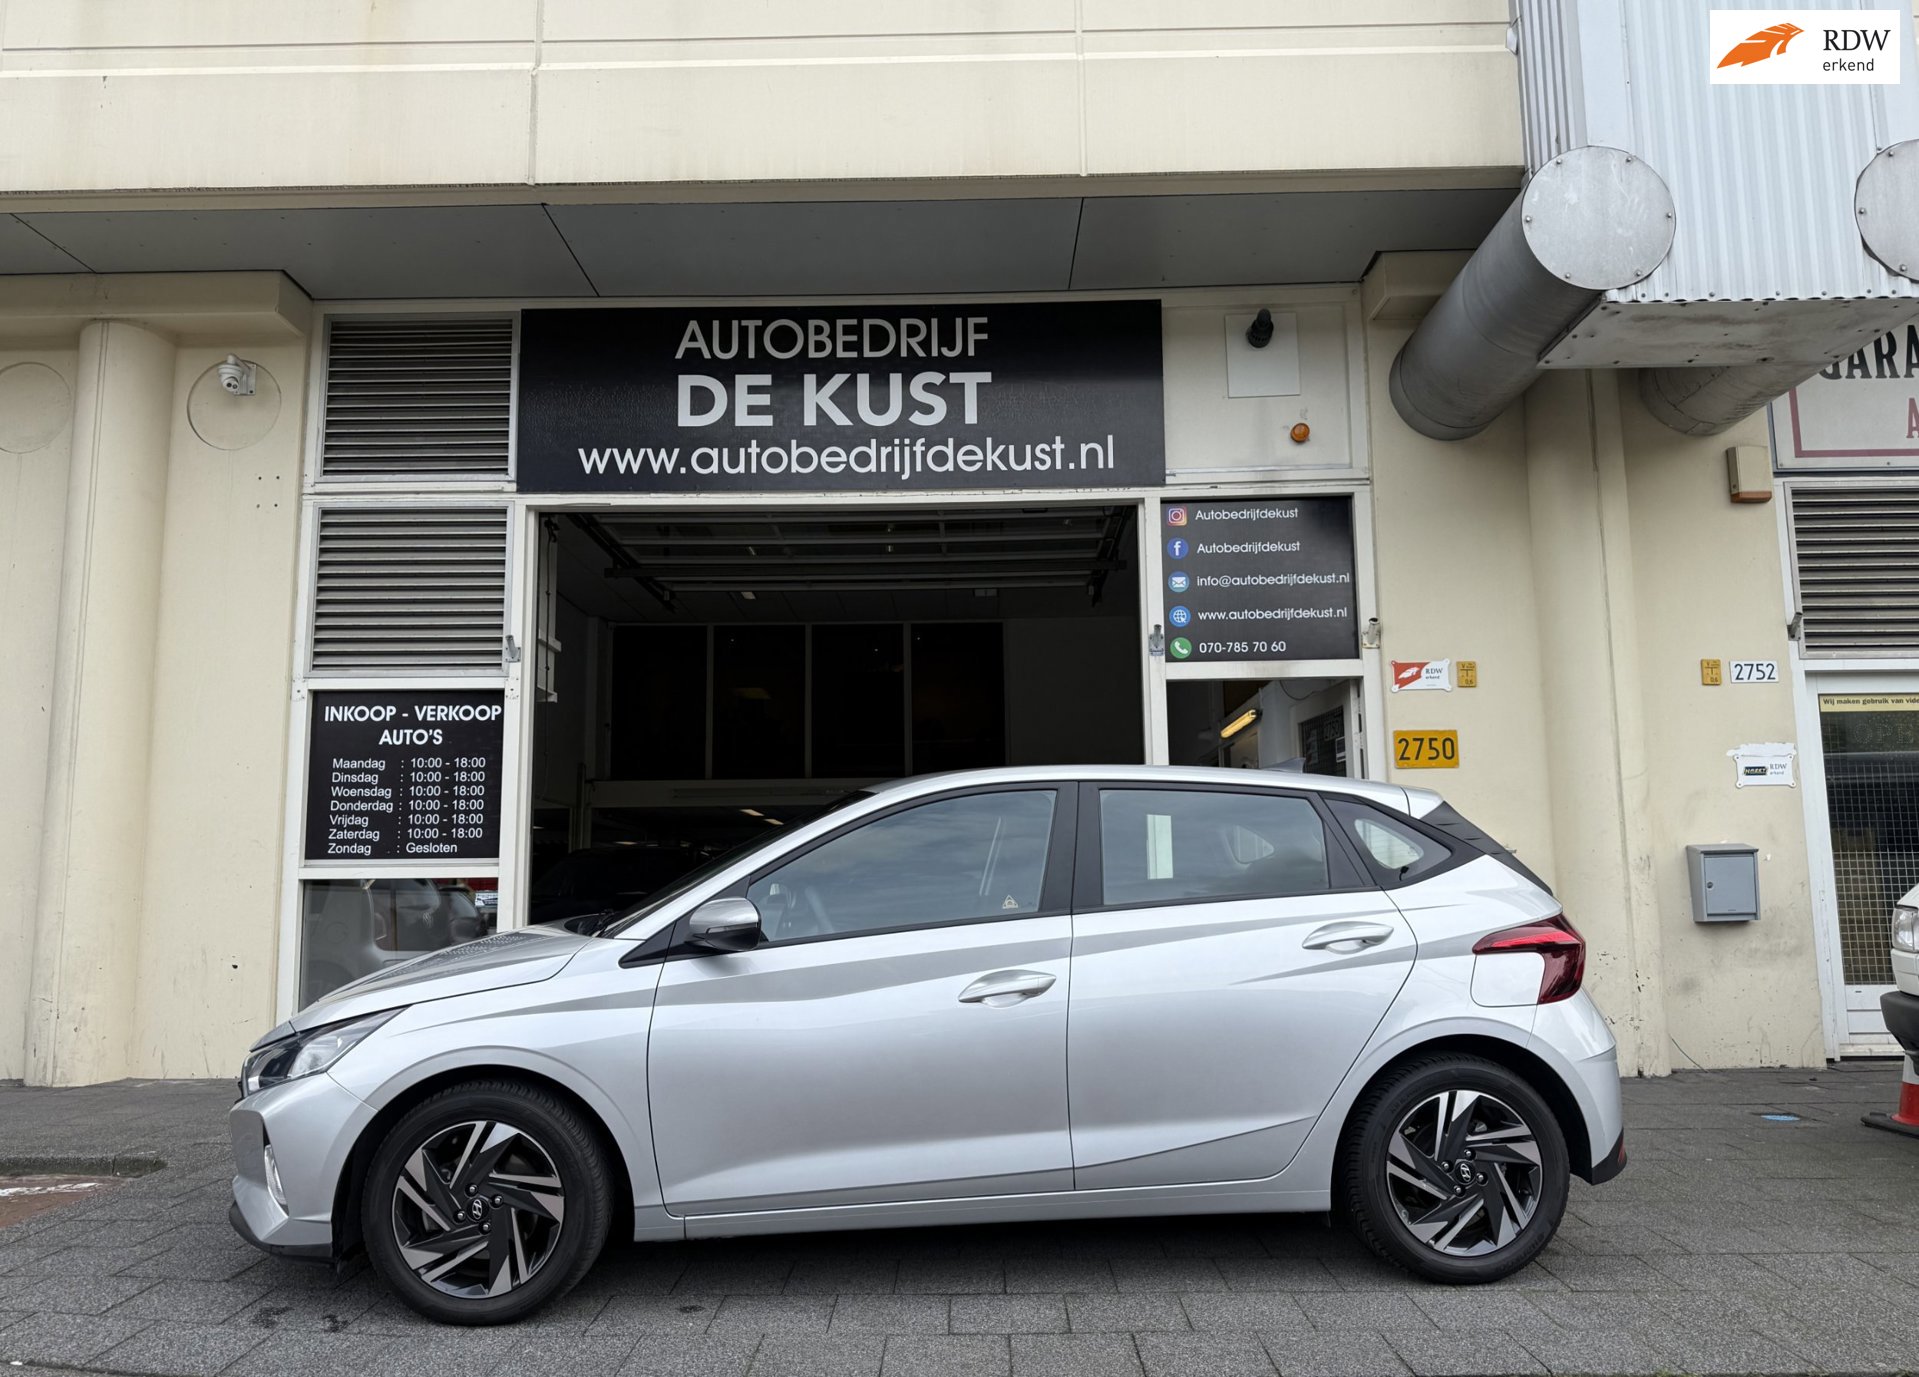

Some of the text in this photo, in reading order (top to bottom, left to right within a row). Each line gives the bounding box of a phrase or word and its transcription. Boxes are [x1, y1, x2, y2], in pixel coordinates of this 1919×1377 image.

[675, 317, 988, 359] AUTOBEDRIJF
[678, 371, 992, 427] DE KUST
[578, 435, 1114, 480] www.autobedrijfdekust.nl
[1195, 508, 1298, 521] Autobedrijfdekust
[1197, 541, 1300, 554] Autobedrijfdekust
[1197, 573, 1350, 587] info@autobedrijfdekust.nl
[1198, 607, 1347, 620] www.autobedrijfdekust.nl
[1199, 641, 1286, 653] 070-785 70 60
[1734, 663, 1776, 680] 2752
[325, 705, 396, 721] INKOOP
[414, 705, 502, 721] VERKOOP
[378, 729, 443, 745] AUTO'S
[1398, 737, 1455, 760] 2750
[333, 758, 386, 771] Maandag
[410, 757, 442, 768] 10:00
[454, 757, 486, 768] 18:00
[332, 772, 378, 785] Dinsdag
[410, 771, 441, 782] 10:00
[453, 771, 485, 782] 18:00
[331, 786, 392, 799] Woensdag
[409, 785, 441, 796] 10:00
[452, 785, 484, 796] 18:00
[330, 800, 393, 813] Donderdag
[408, 800, 440, 810] 10:00
[452, 799, 484, 810] 18:00
[329, 814, 369, 827] Vrijdag
[408, 814, 440, 825] 10:00
[451, 813, 483, 824] 18:00
[328, 829, 380, 841] Zaterdag
[407, 828, 439, 839] 10:00
[451, 827, 483, 838] 18:00
[328, 843, 371, 856] Zondag
[406, 842, 458, 853] Gesloten
